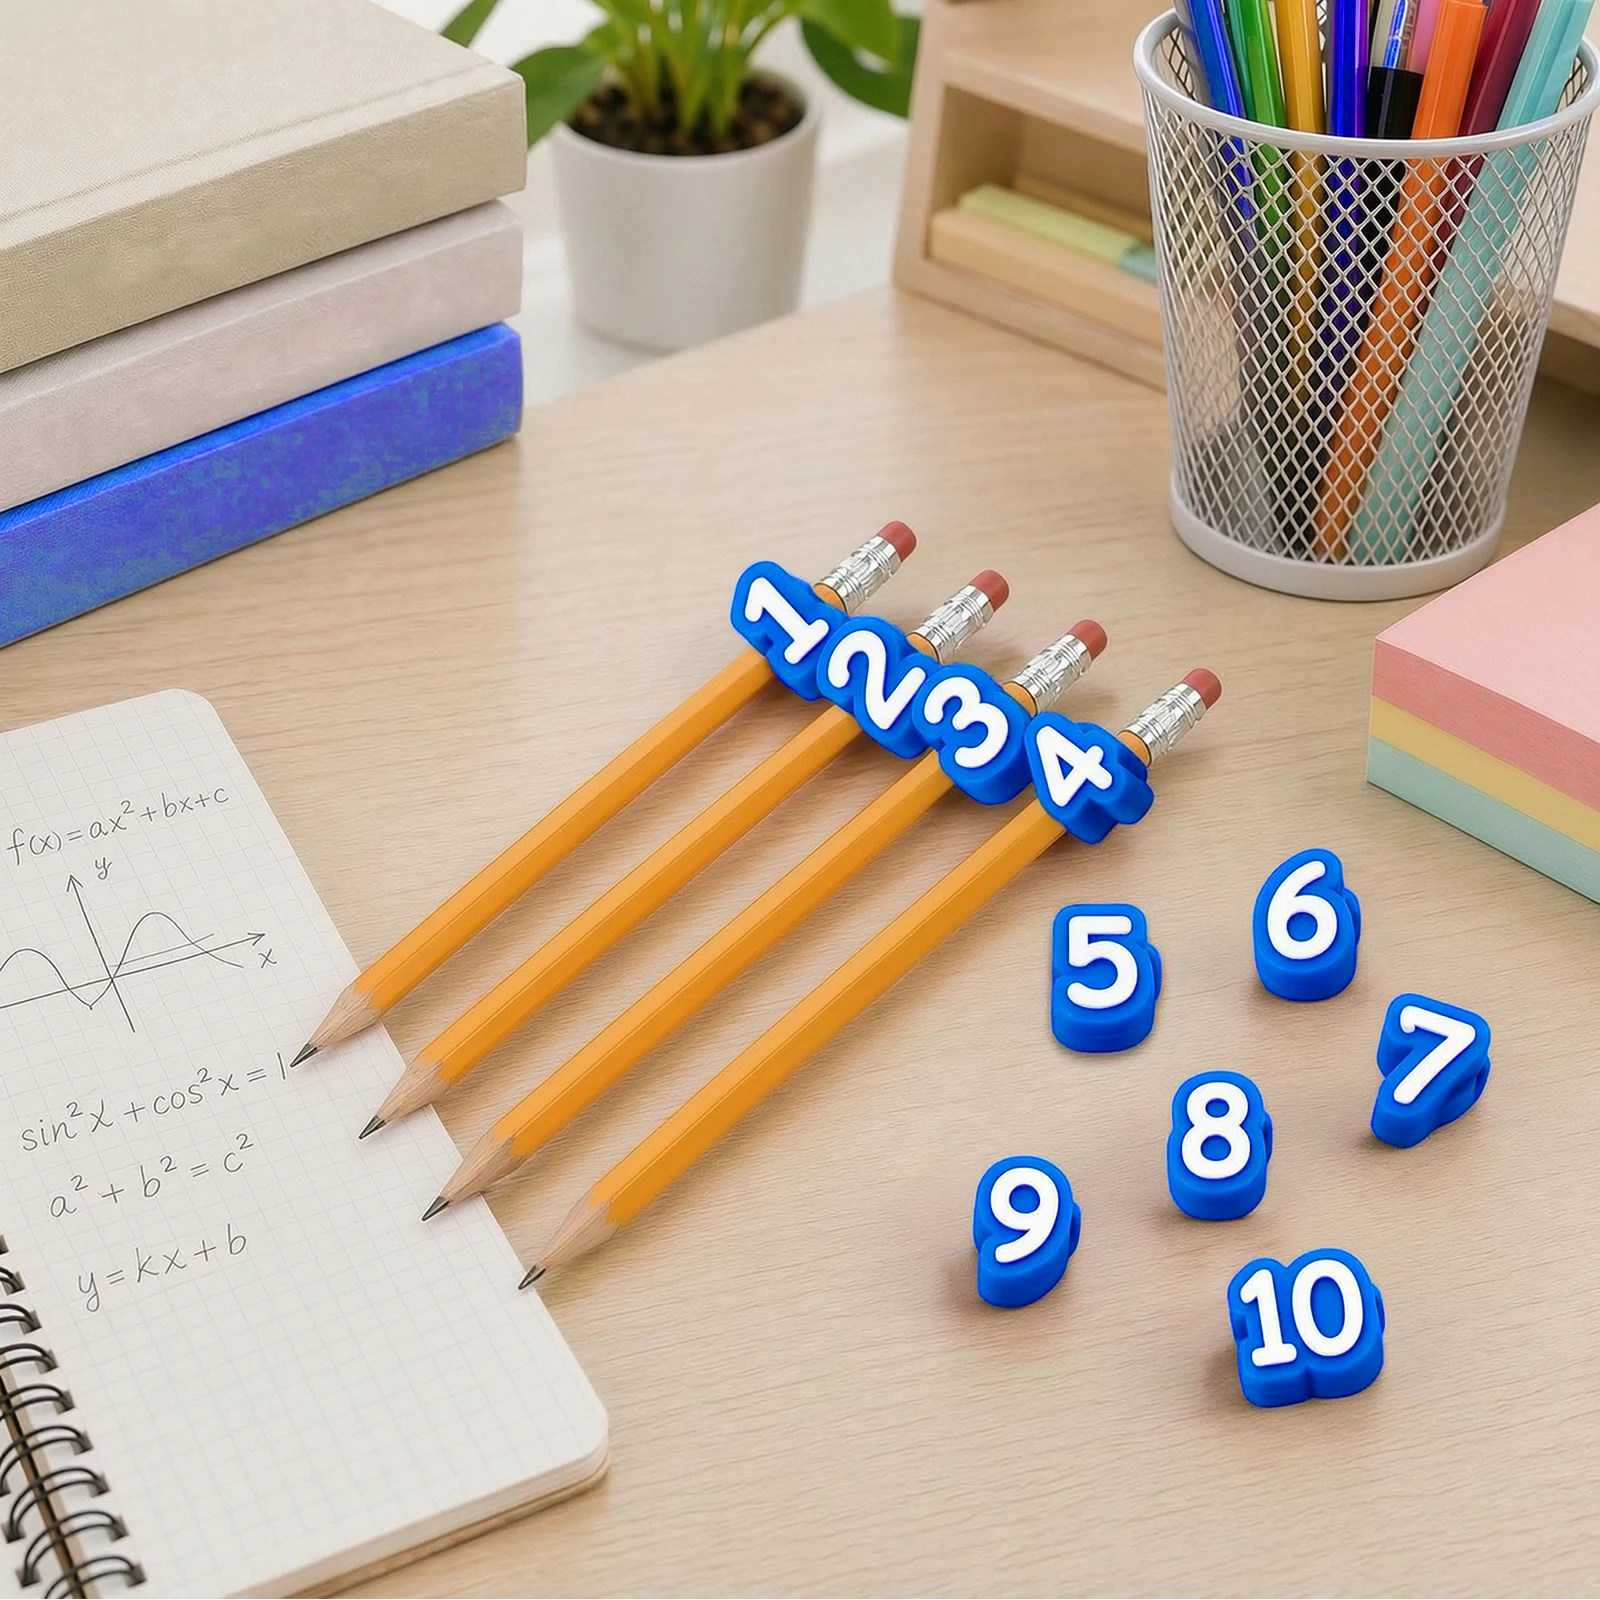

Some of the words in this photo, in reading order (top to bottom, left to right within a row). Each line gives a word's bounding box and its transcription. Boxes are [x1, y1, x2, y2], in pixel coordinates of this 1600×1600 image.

[744, 576, 830, 665] 1
[827, 629, 927, 731] 2
[923, 676, 1009, 768] 3
[1035, 725, 1113, 808] 4
[94, 856, 112, 881] y
[1266, 860, 1338, 960] 6
[257, 948, 278, 969] x
[1066, 915, 1138, 1009] 5
[1393, 1005, 1477, 1105] 7
[1181, 1081, 1251, 1180] 8
[990, 1166, 1060, 1263] 9
[1239, 1258, 1364, 1367] 10
